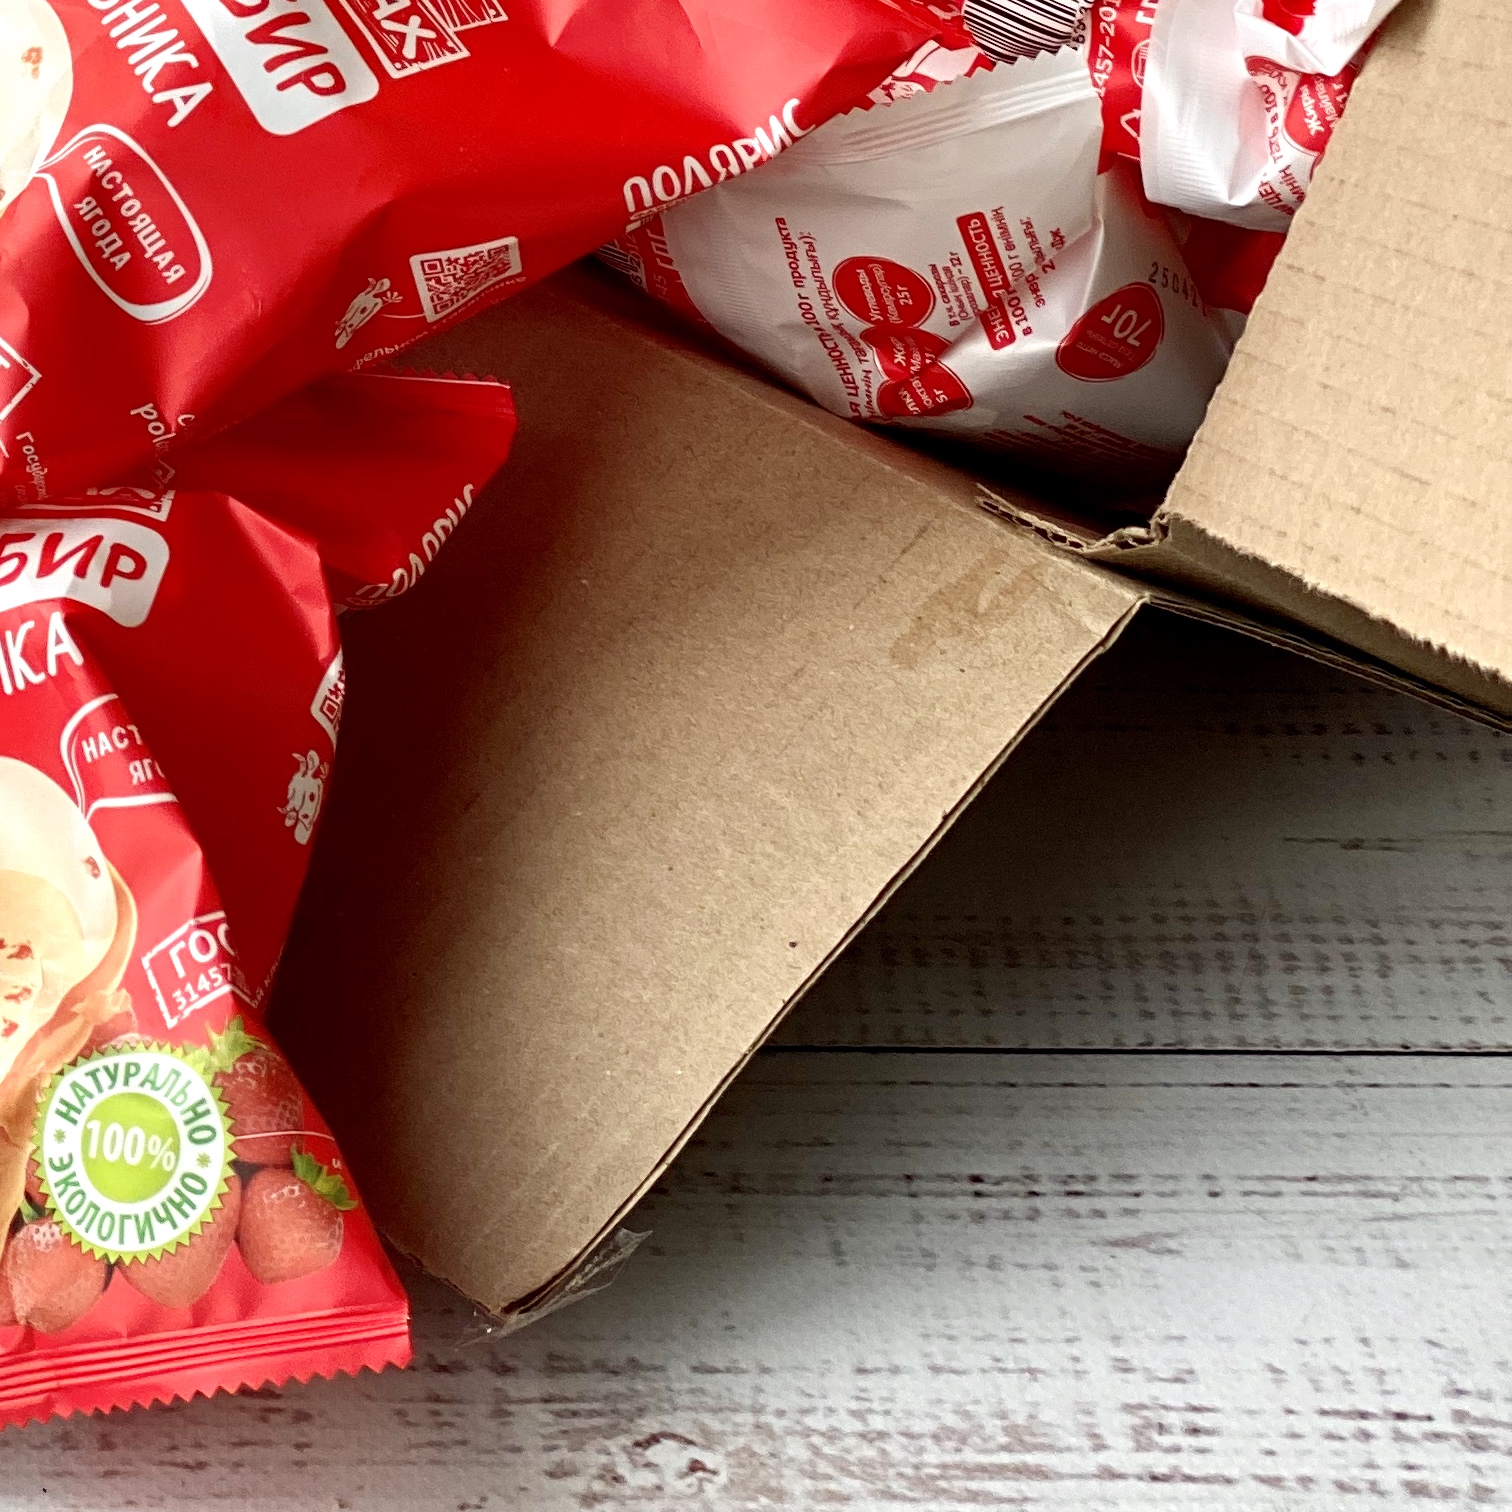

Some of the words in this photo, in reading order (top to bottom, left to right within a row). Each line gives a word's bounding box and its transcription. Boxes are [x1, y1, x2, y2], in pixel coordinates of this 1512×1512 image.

[1299, 84, 1326, 137] Жиры
[623, 97, 818, 214] ПОЛЯРИС
[72, 195, 133, 273] ЯГОДА
[82, 144, 187, 287] НАСТОЯЩАЯ
[774, 216, 807, 290] продукта
[966, 217, 1005, 290] ЦЕННОСТЬ
[895, 284, 914, 306] 25г
[1101, 303, 1152, 348] 70г
[168, 924, 238, 979] ГОС
[171, 961, 236, 1012] 31457
[53, 1060, 217, 1146] НАТУРАЛЬНО
[85, 1118, 178, 1173] 100%
[48, 1150, 208, 1247] ЭКОЛОГИЧНО
